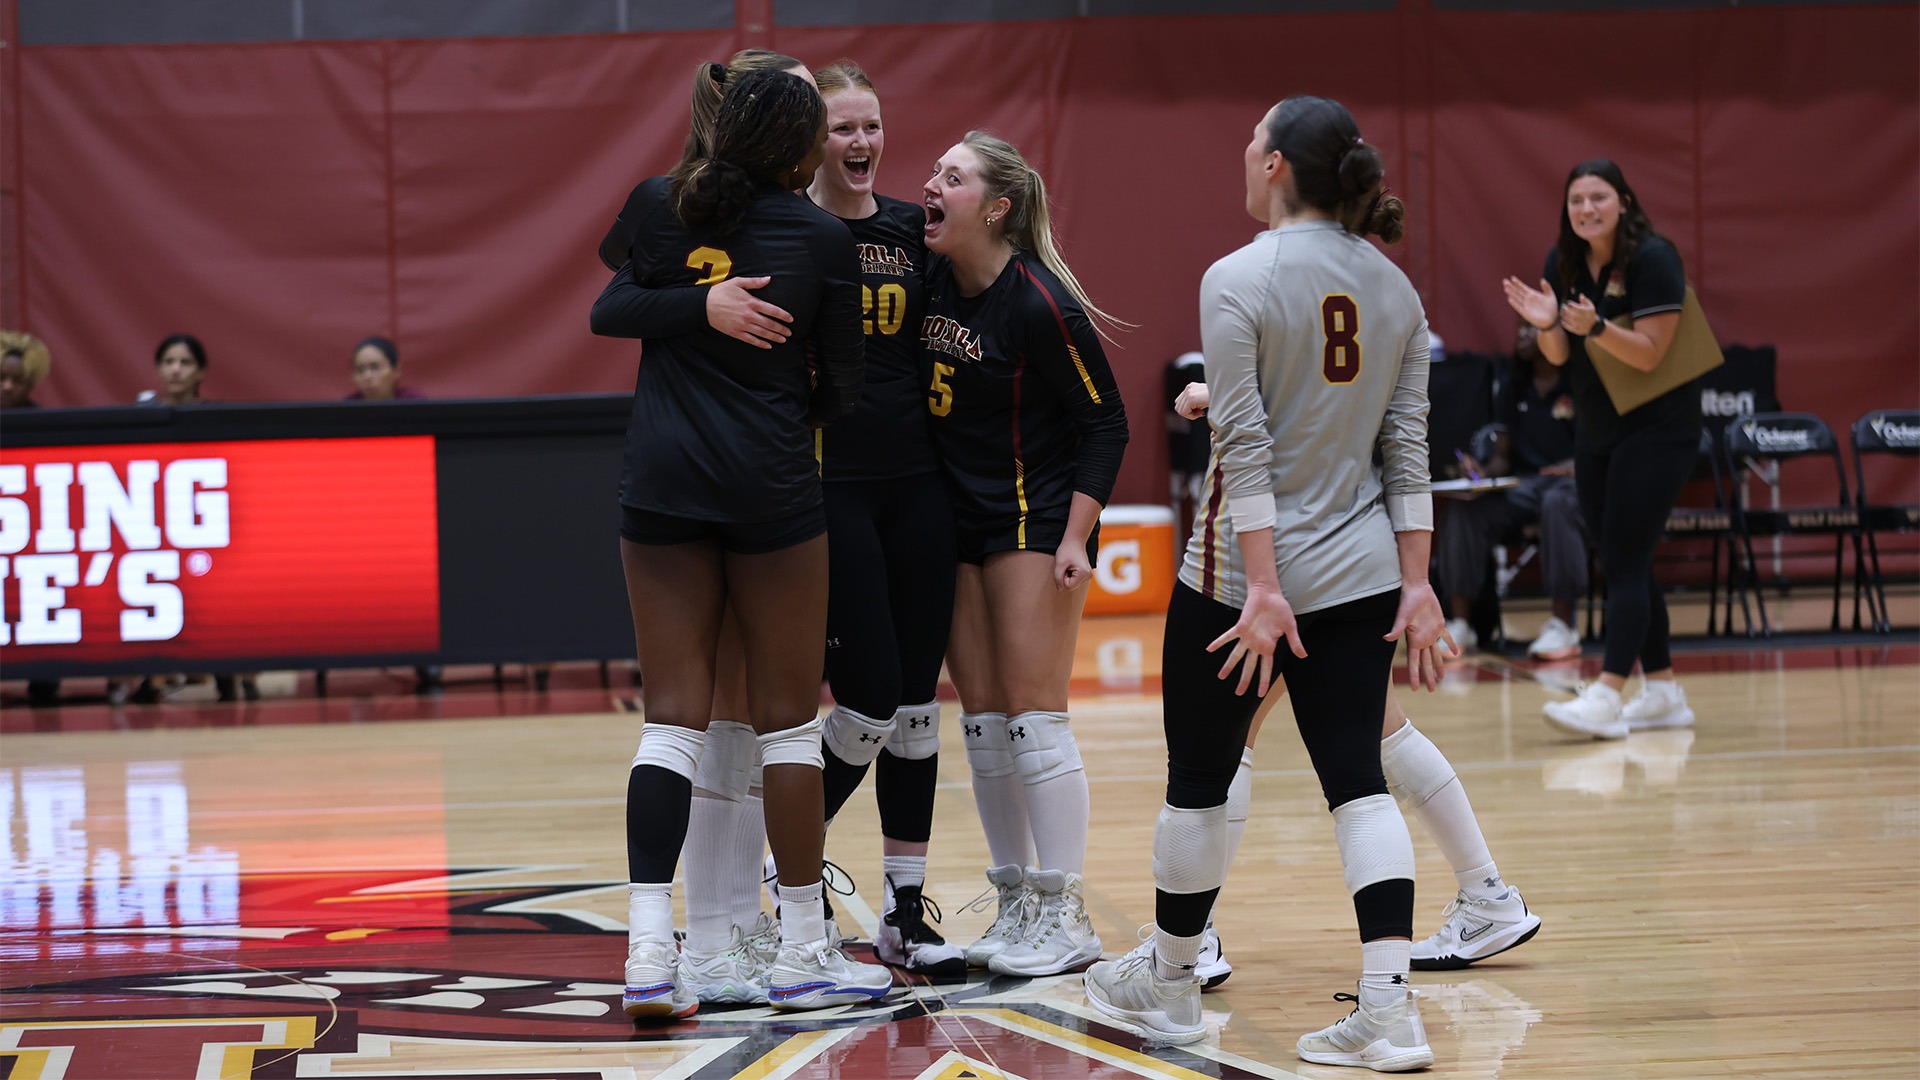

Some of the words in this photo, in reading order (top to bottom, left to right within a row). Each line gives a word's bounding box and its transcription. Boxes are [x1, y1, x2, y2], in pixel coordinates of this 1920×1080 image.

[1321, 292, 1363, 386] 8
[928, 361, 956, 417] 5
[0, 549, 185, 645] E’S
[1096, 539, 1142, 595] G
